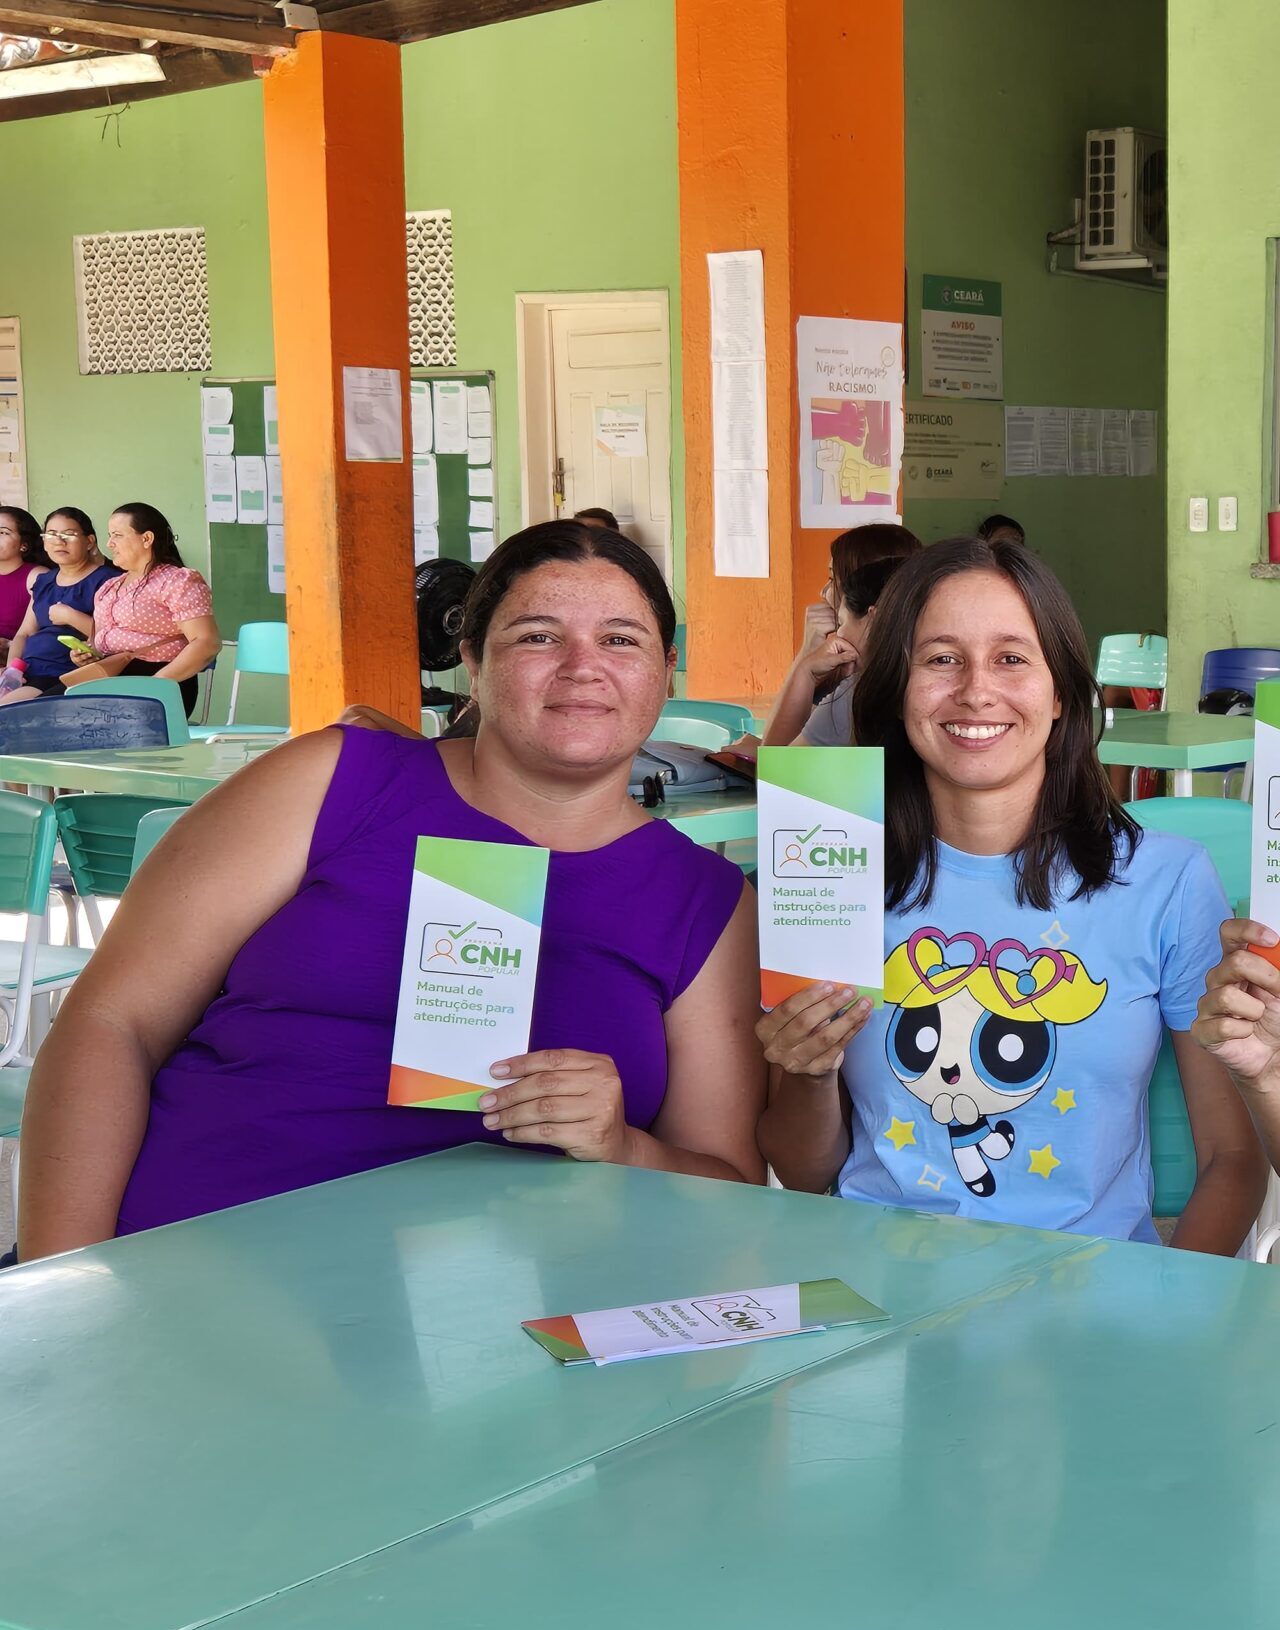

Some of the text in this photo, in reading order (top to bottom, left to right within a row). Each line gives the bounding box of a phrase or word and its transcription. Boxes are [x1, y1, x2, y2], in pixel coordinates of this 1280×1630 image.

[954, 290, 984, 302] CEARÁ
[951, 321, 975, 331] AVISO
[829, 381, 877, 394] RACISMO!
[904, 412, 953, 426] ERTIFICADO
[809, 847, 867, 867] CNH
[773, 887, 835, 897] Manual de
[773, 901, 867, 915] instruções para
[773, 917, 851, 926] atendimento
[460, 943, 522, 968] CNH
[478, 965, 520, 976] POPULAR
[417, 981, 483, 996] Manual de
[416, 995, 515, 1014] instruções para
[413, 1012, 497, 1027] atendimento
[721, 1310, 765, 1332] CNH
